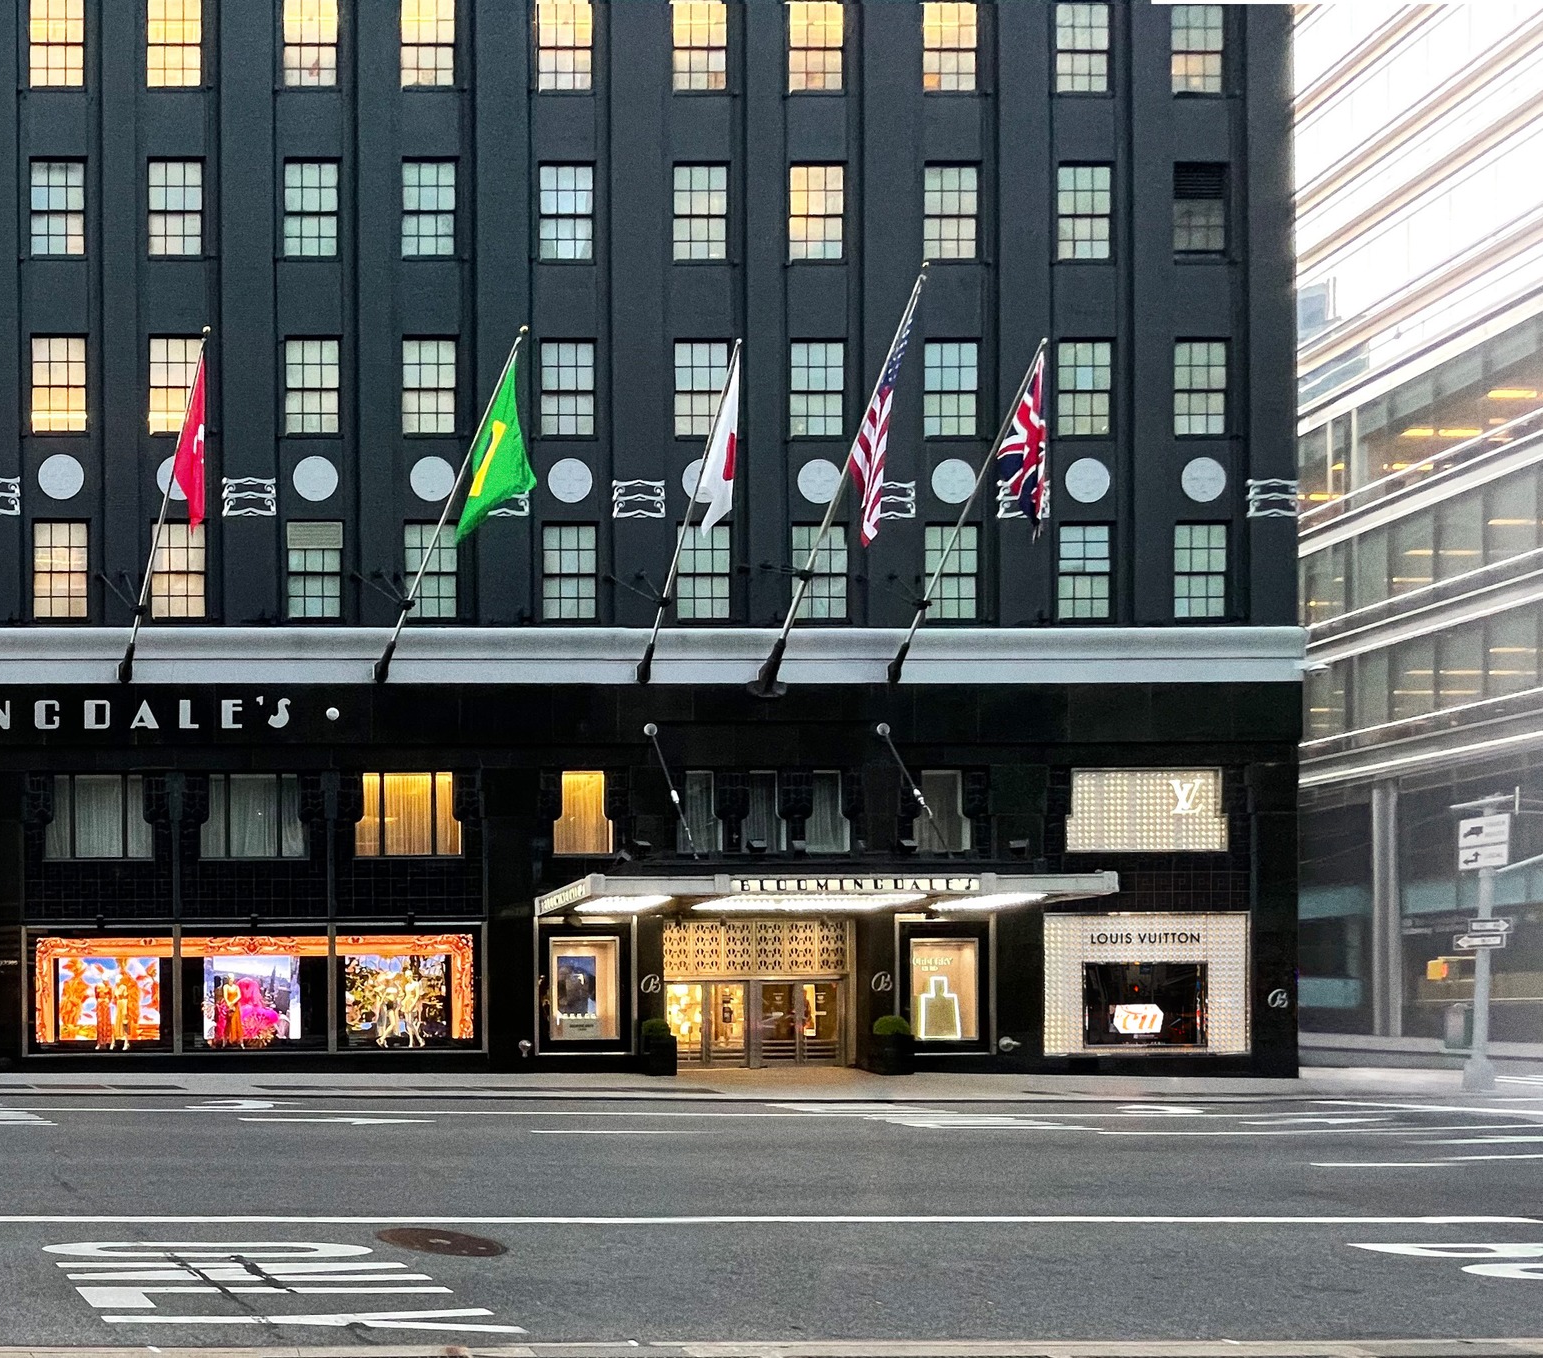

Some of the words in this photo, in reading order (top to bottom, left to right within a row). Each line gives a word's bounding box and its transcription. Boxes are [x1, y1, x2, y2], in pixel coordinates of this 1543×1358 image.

[1090, 932, 1133, 945] LOUIS
[1138, 932, 1201, 945] VUITTON
[41, 1241, 529, 1334] ONLY
